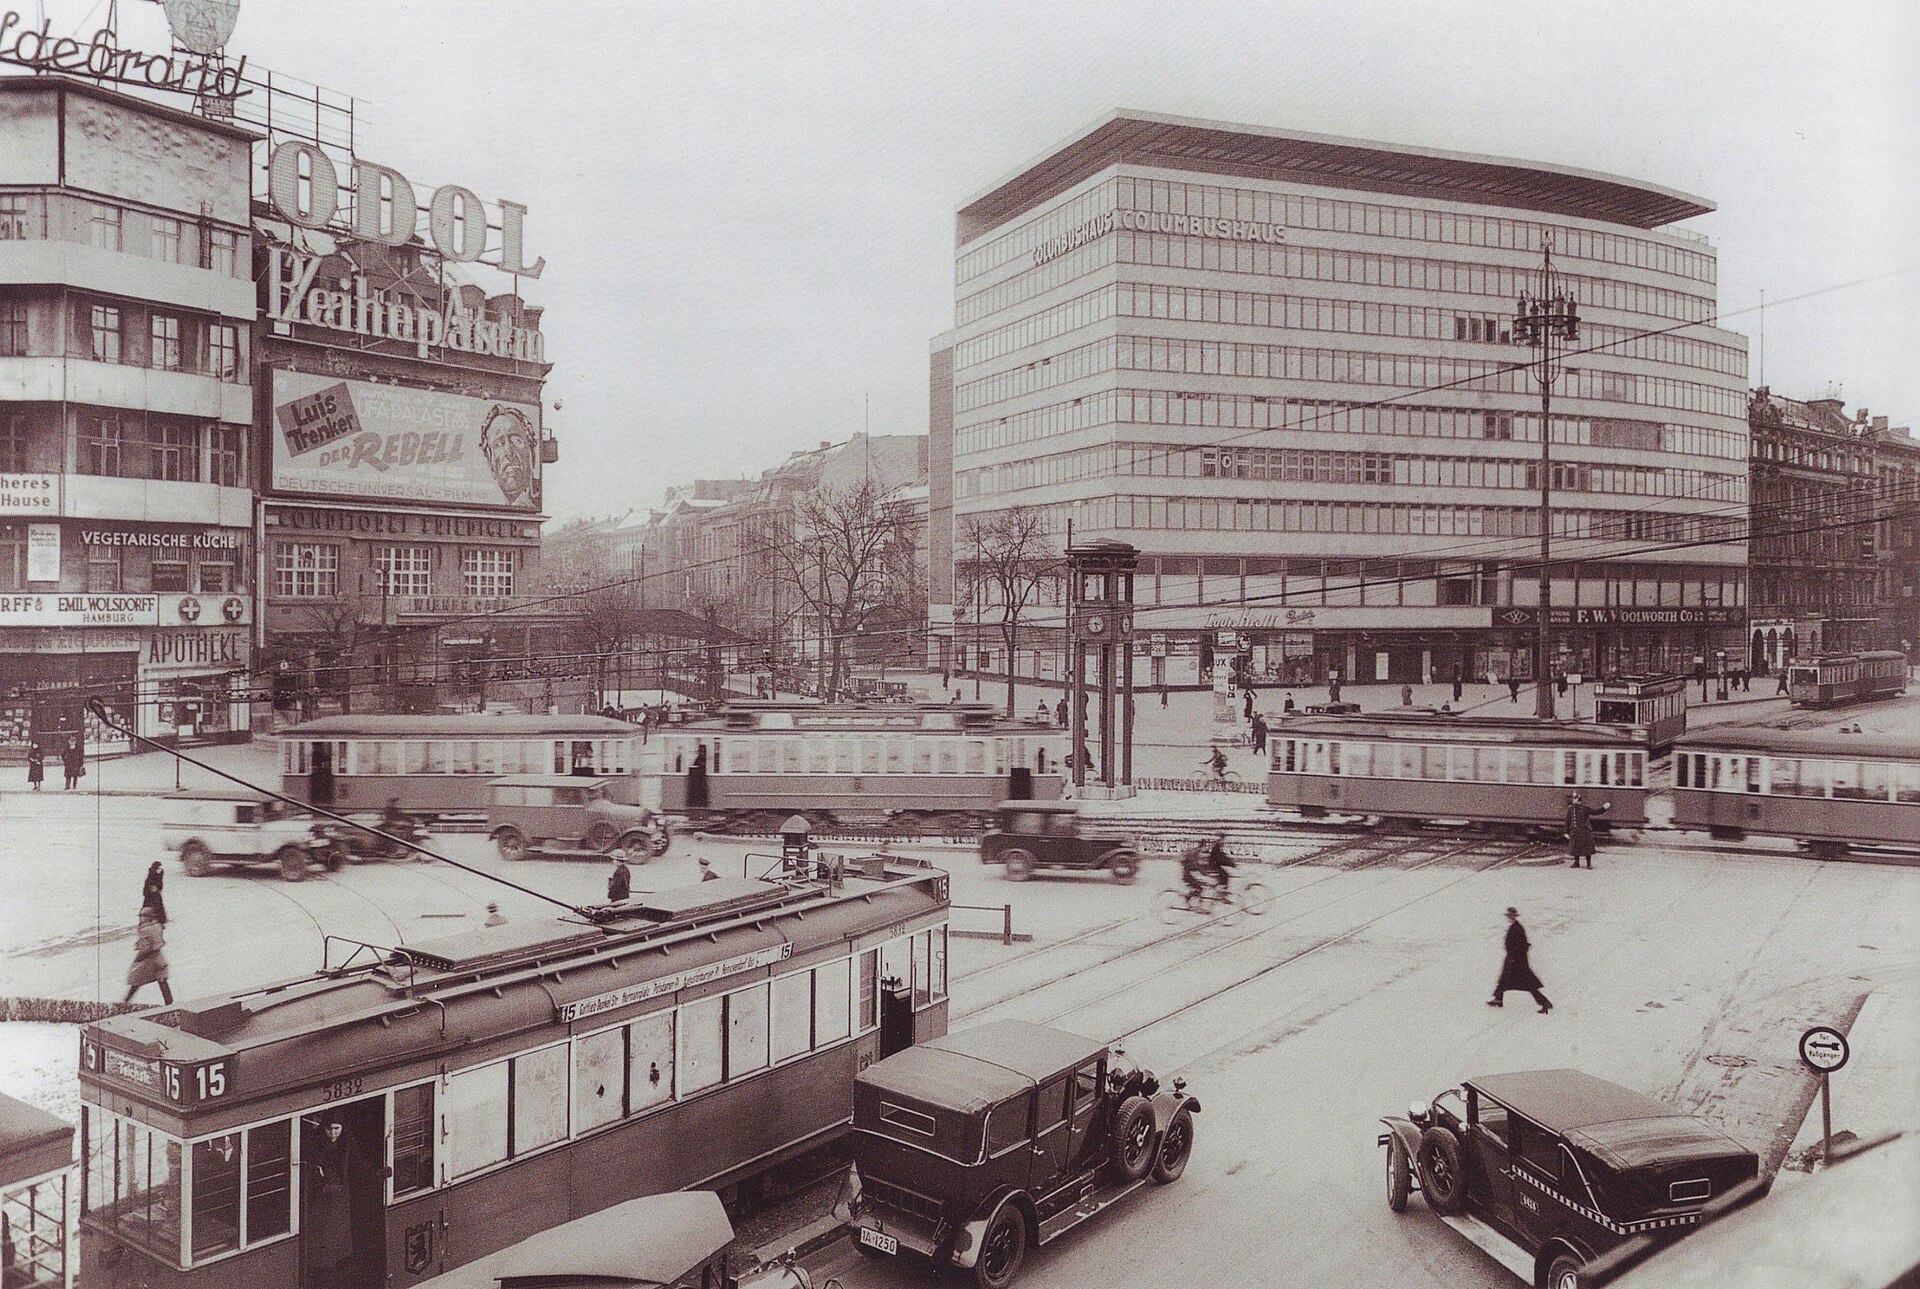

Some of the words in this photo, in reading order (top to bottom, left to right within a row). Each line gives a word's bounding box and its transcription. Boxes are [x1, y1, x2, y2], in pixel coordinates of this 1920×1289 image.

[269, 140, 546, 279] ODOL
[1033, 212, 1114, 265] COLUMBUSHAUS
[1122, 209, 1287, 243] COLUMBUSHAUS
[290, 393, 338, 427] Luis
[286, 413, 354, 451] Trenker
[320, 446, 351, 467] DER
[349, 431, 465, 472] REBELL
[279, 477, 355, 493] DEUTSCHE
[1, 494, 50, 507] Hause
[81, 530, 187, 548] VEGETARISCHE
[193, 531, 236, 549] KÜCHE
[58, 597, 86, 612] EMIL
[89, 597, 156, 612] WOLSDORFF
[1577, 610, 1589, 623] F.
[1592, 610, 1607, 623] W.
[83, 613, 134, 623] HAMBURG
[149, 631, 242, 665] APOTHEKE
[938, 878, 948, 900] 15
[780, 944, 791, 960] 15
[563, 1003, 577, 1021] 15
[165, 1064, 180, 1101] 15
[196, 1062, 226, 1100] 15
[323, 1077, 363, 1102] 5832
